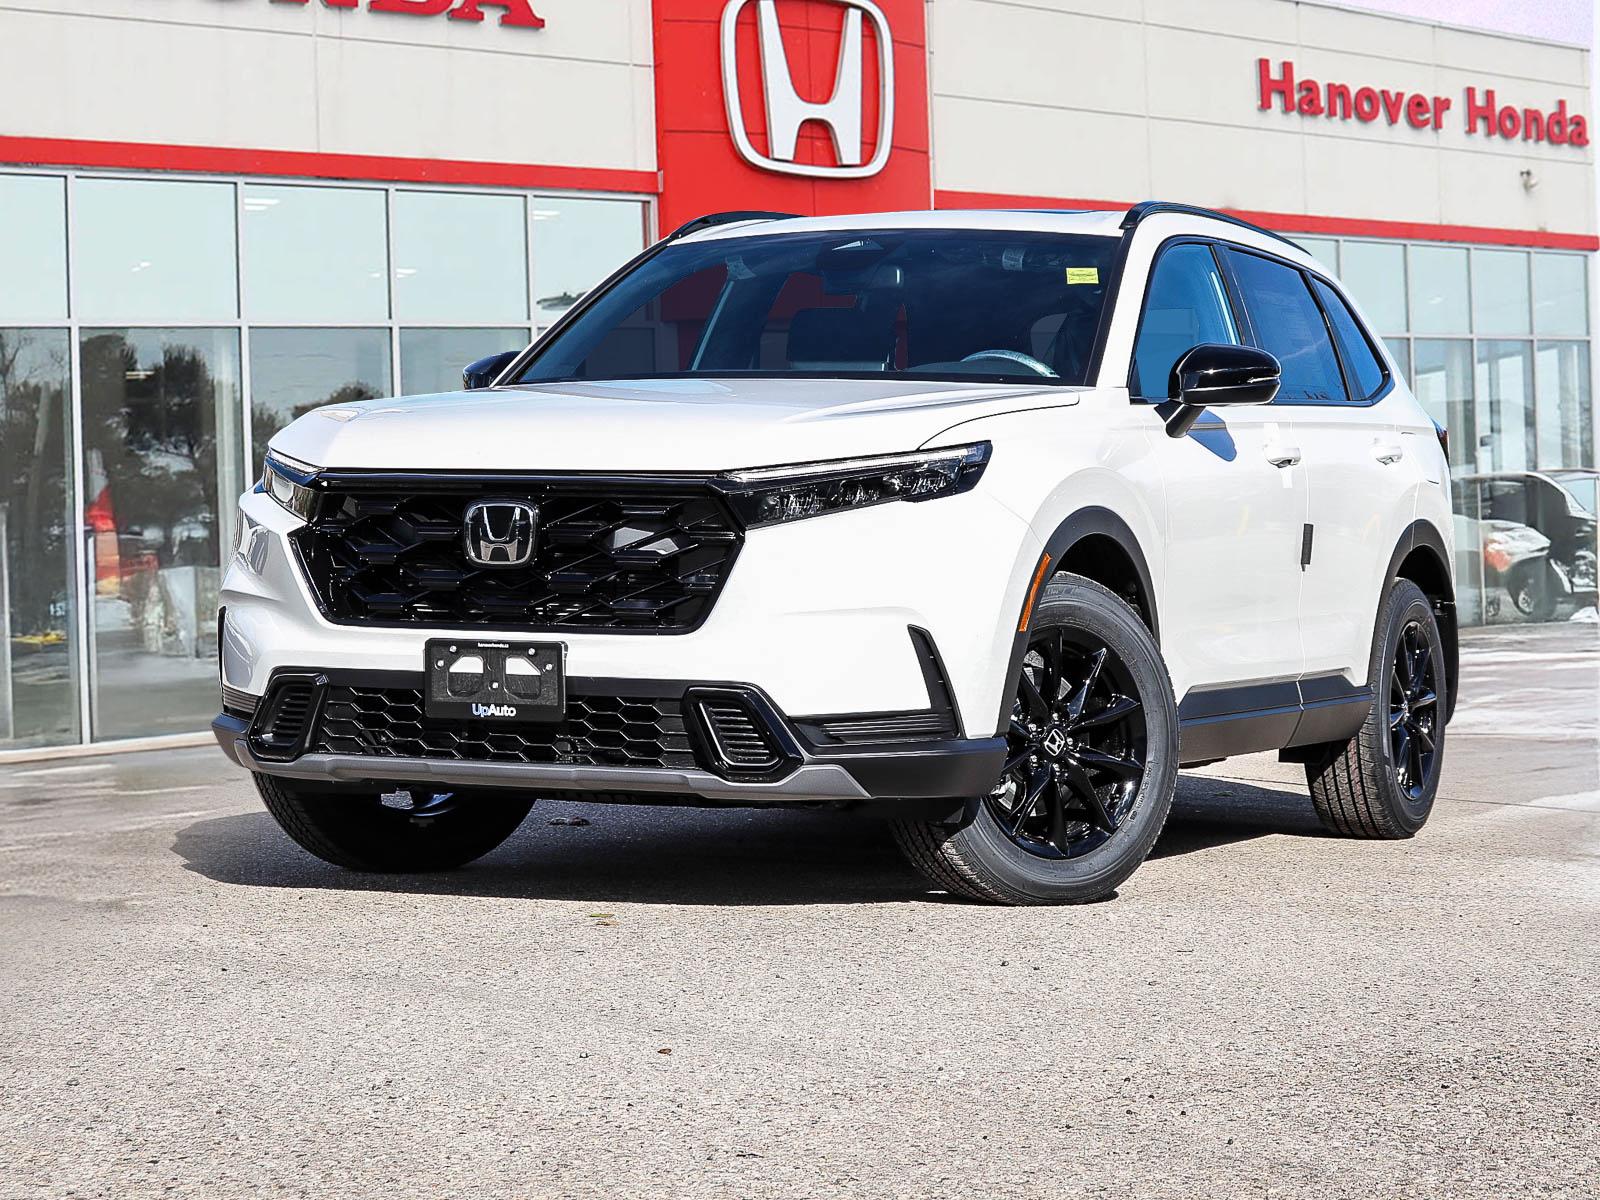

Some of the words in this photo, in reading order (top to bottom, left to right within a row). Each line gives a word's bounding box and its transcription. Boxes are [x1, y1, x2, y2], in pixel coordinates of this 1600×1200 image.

[1257, 57, 1452, 130] Hanover
[1465, 86, 1590, 147] Honda
[471, 703, 517, 718] UpAuto
